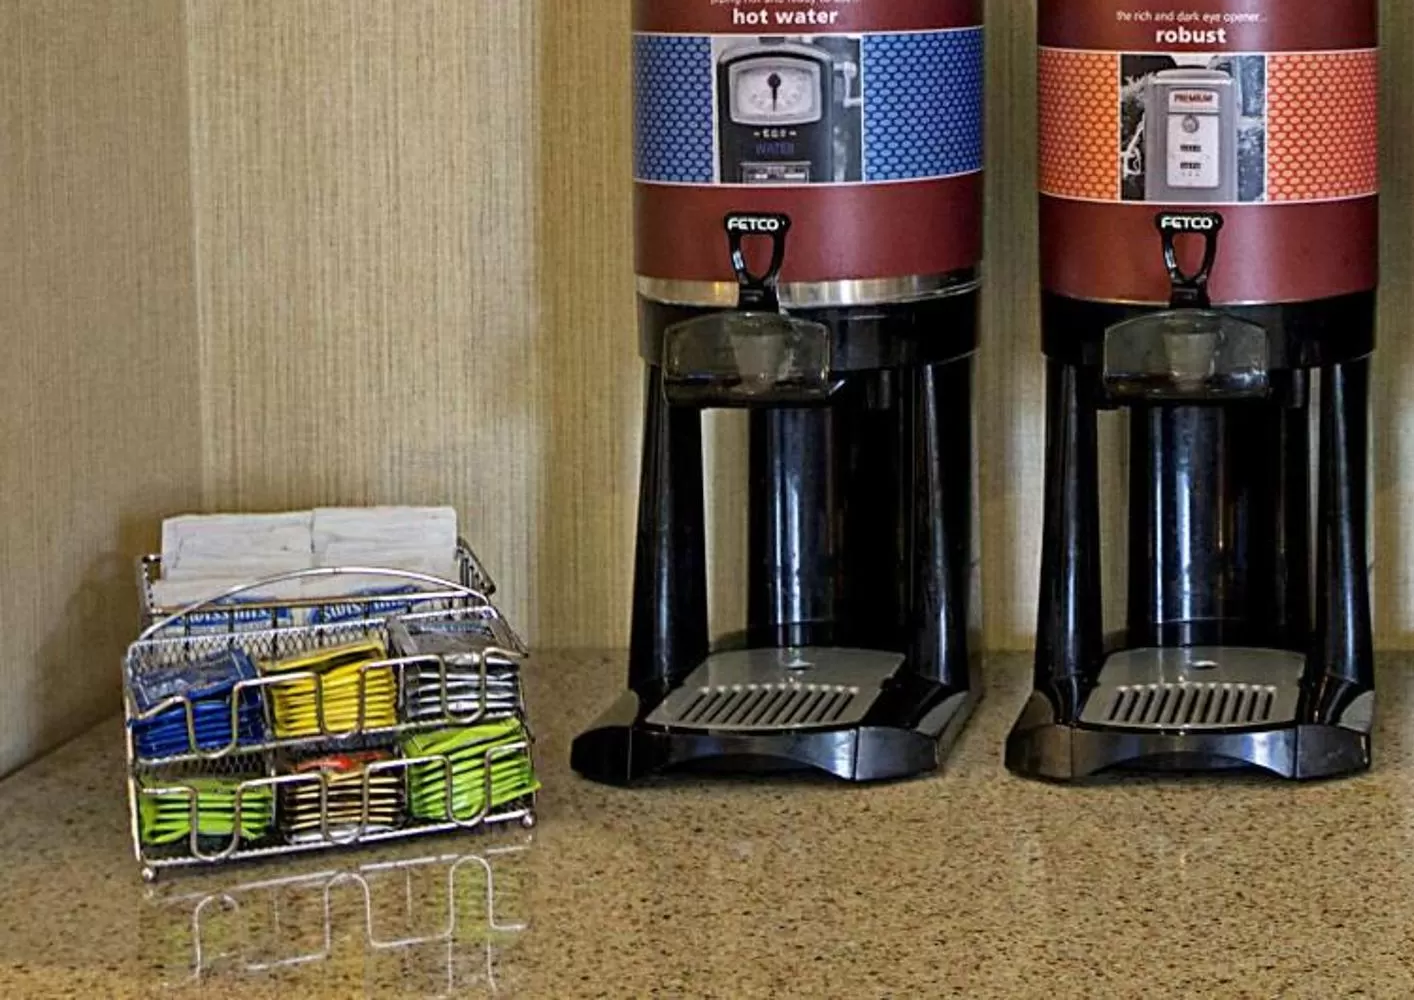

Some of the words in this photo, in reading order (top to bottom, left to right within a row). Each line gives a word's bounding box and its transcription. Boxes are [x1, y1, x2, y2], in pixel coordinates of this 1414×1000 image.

[732, 7, 769, 25] hot
[774, 9, 839, 25] water
[1115, 10, 1132, 21] the
[1134, 10, 1152, 22] rich
[1154, 10, 1175, 22] and
[1176, 11, 1200, 23] dark
[1202, 14, 1221, 24] eye
[1155, 26, 1227, 44] robust
[727, 217, 779, 231] FETCO
[1160, 216, 1214, 230] FETCO
